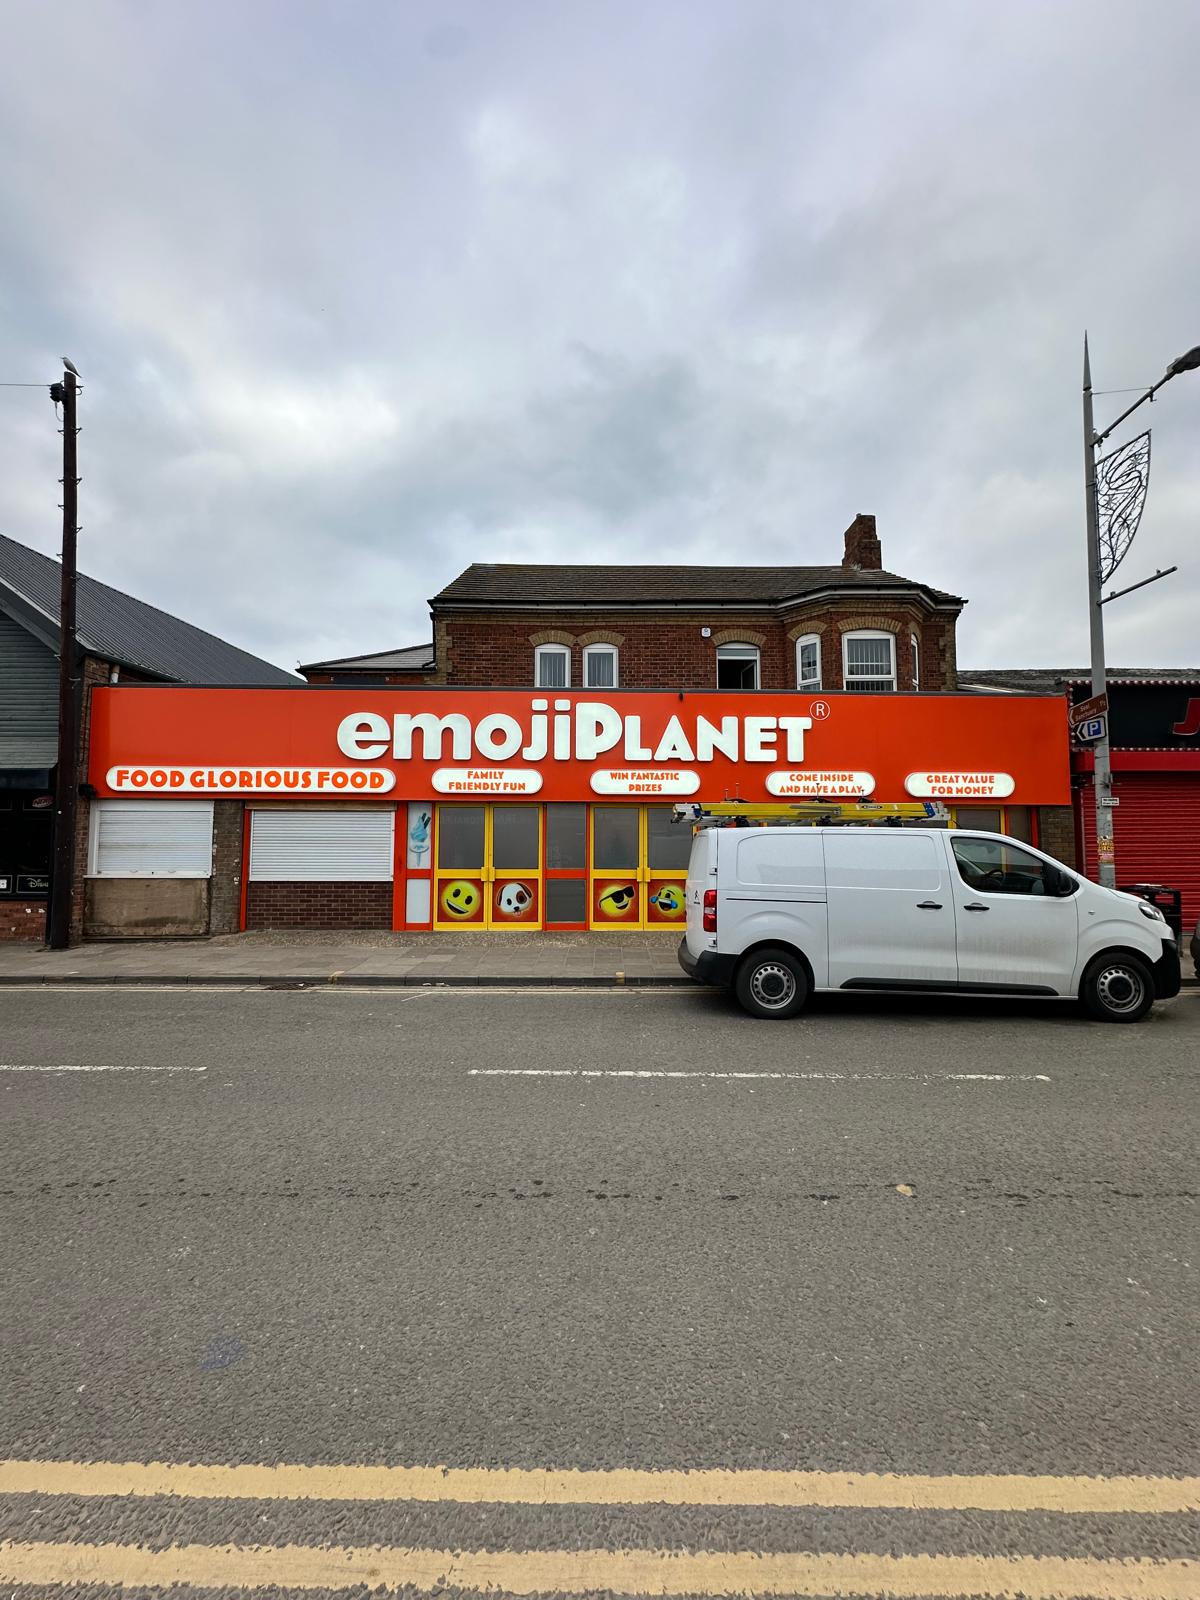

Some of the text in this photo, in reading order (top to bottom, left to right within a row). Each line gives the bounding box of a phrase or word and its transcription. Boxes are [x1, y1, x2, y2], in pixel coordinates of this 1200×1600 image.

[336, 698, 813, 763] emojiPLANET
[1090, 722, 1099, 736] P
[116, 769, 385, 789] FOOD GLORIOUS FOOD
[467, 770, 505, 780] FAMILY
[610, 772, 680, 781] WIN FANTASTIC
[789, 773, 854, 782] COME INSIDE
[926, 775, 995, 784] GREAT VALUE
[448, 781, 526, 791] FRIENDLY FUN
[628, 783, 663, 792] PRIZES
[779, 785, 863, 794] AND HAVE A PLAY
[931, 786, 994, 795] FOR MONEY
